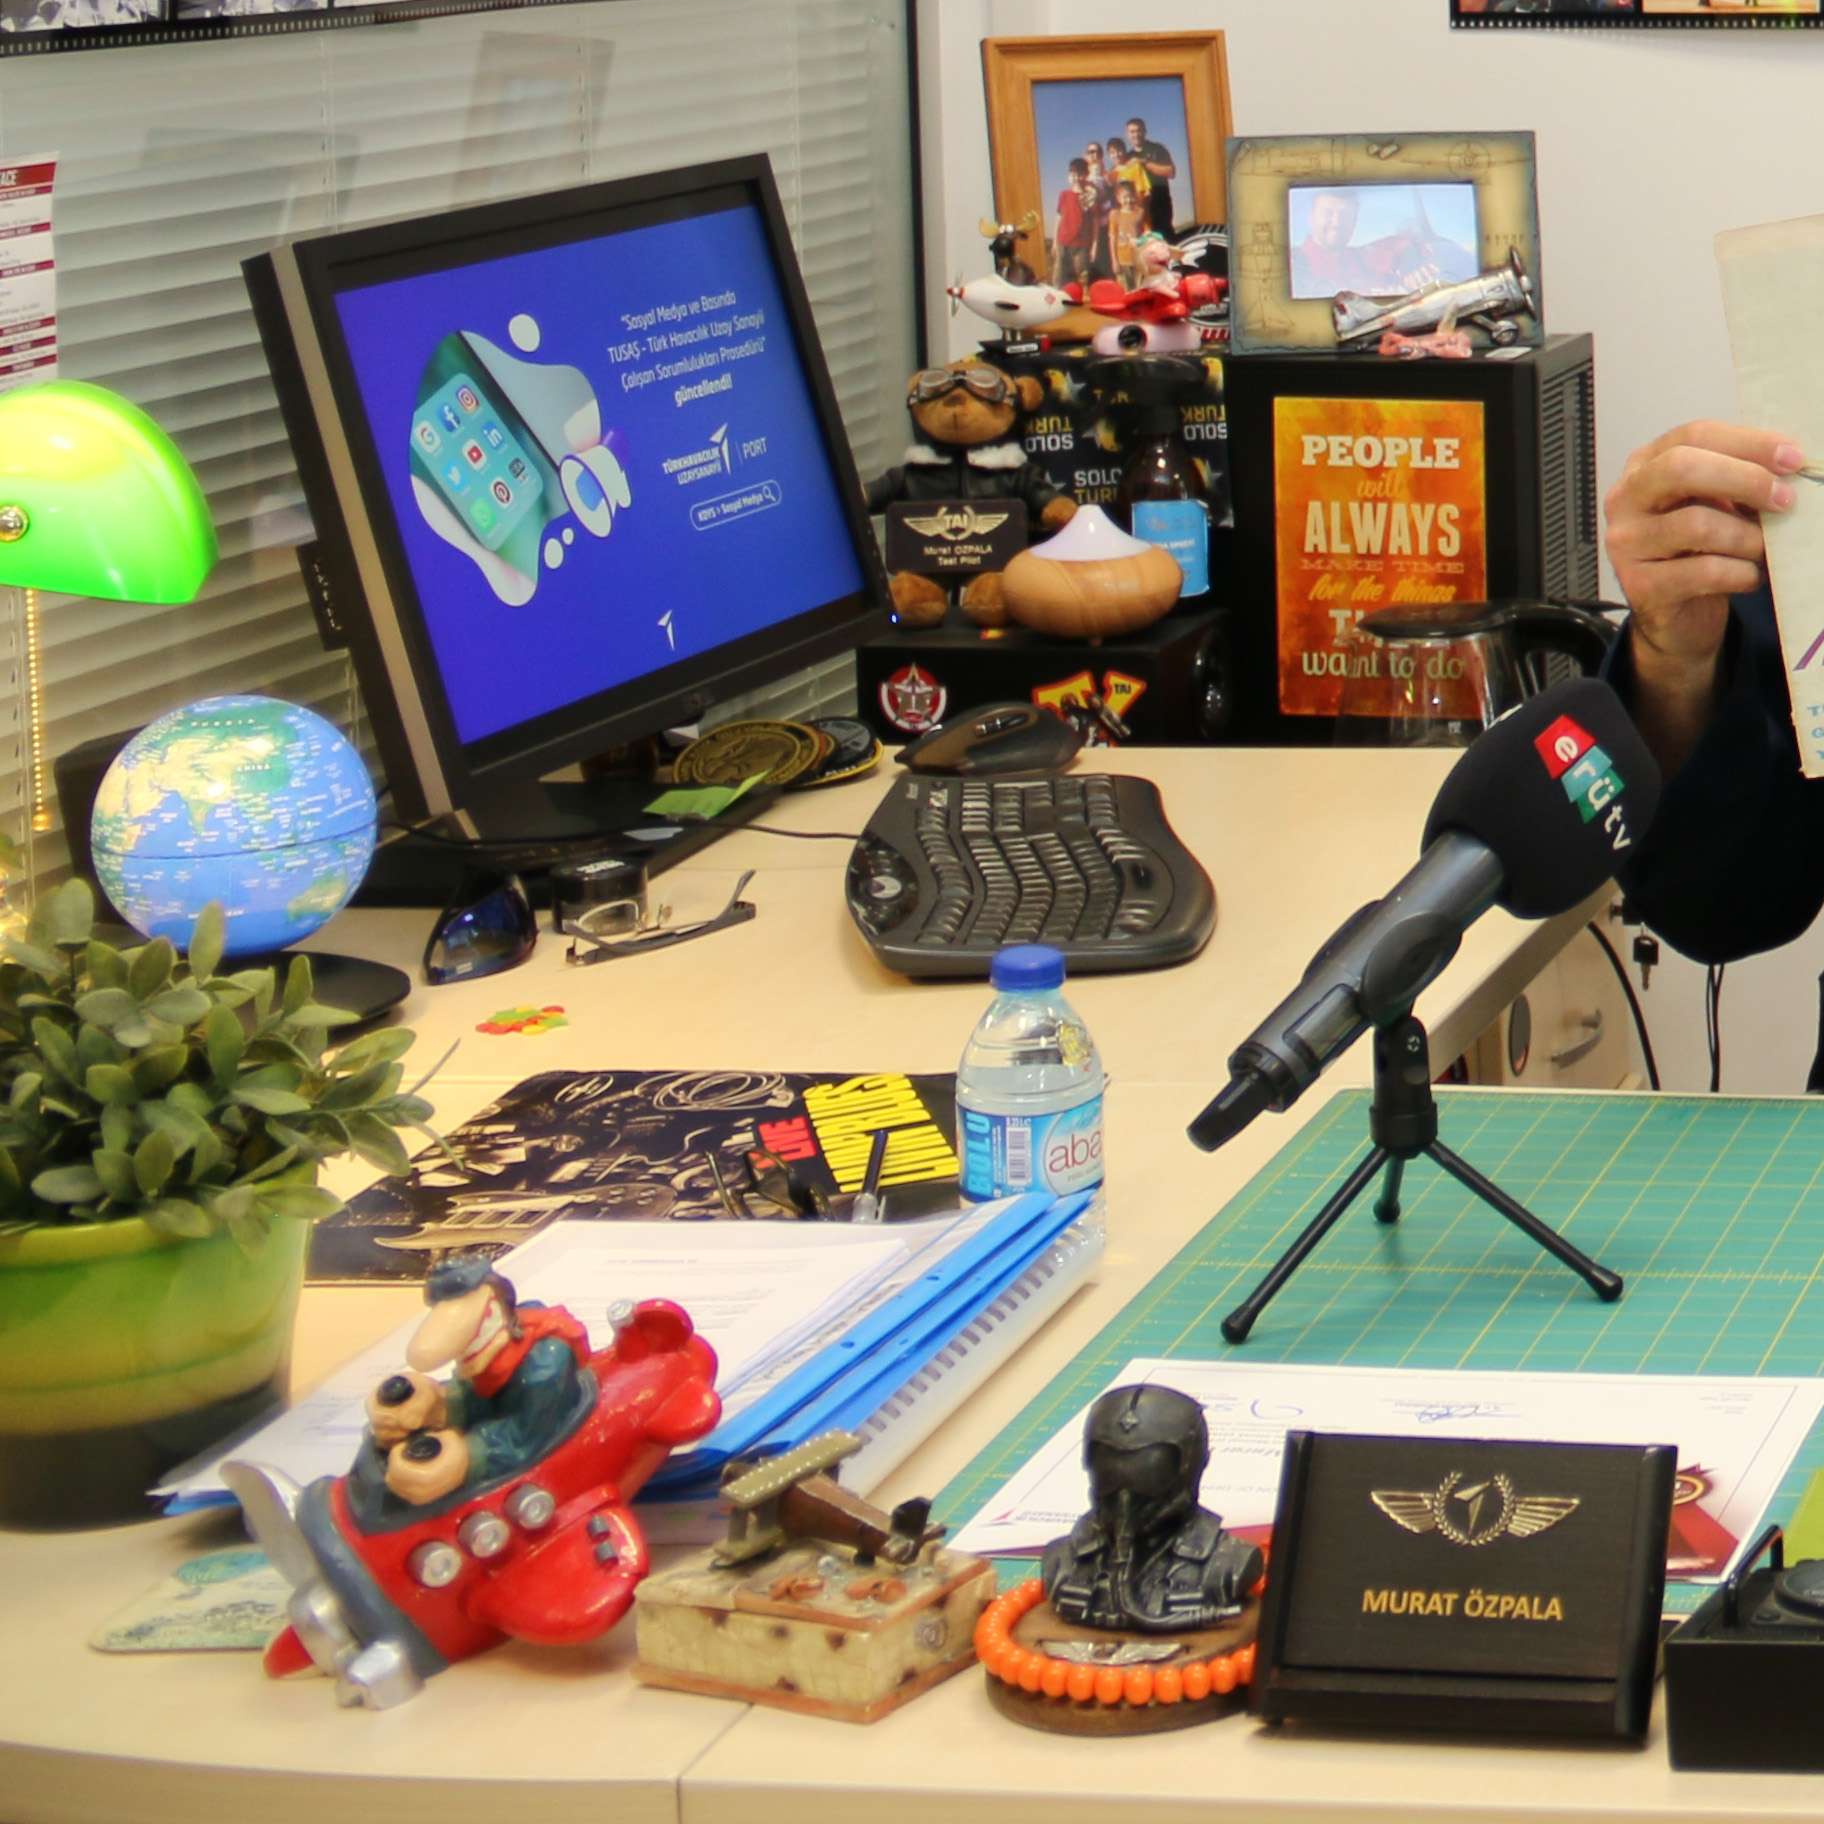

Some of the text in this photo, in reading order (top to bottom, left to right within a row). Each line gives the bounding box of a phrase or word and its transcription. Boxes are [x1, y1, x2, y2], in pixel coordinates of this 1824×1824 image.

[607, 341, 641, 364] TUSAŞ
[710, 317, 734, 338] Uzay
[1024, 434, 1075, 452] SOLO
[1182, 422, 1229, 442] SOLO
[742, 437, 769, 460] PORT
[1301, 435, 1460, 469] PEOPLE
[1356, 472, 1402, 498] will
[944, 513, 969, 530] TAI
[1303, 500, 1461, 558] ALWAYS
[923, 546, 953, 557] Murat
[936, 555, 982, 567] Test Pilot
[1299, 558, 1466, 575] MAKE TIME
[1308, 573, 1458, 604] for the things
[1301, 648, 1466, 680] want to do
[965, 1111, 996, 1197] BOLU
[1362, 1588, 1564, 1622] MURAT ÖZPALA
